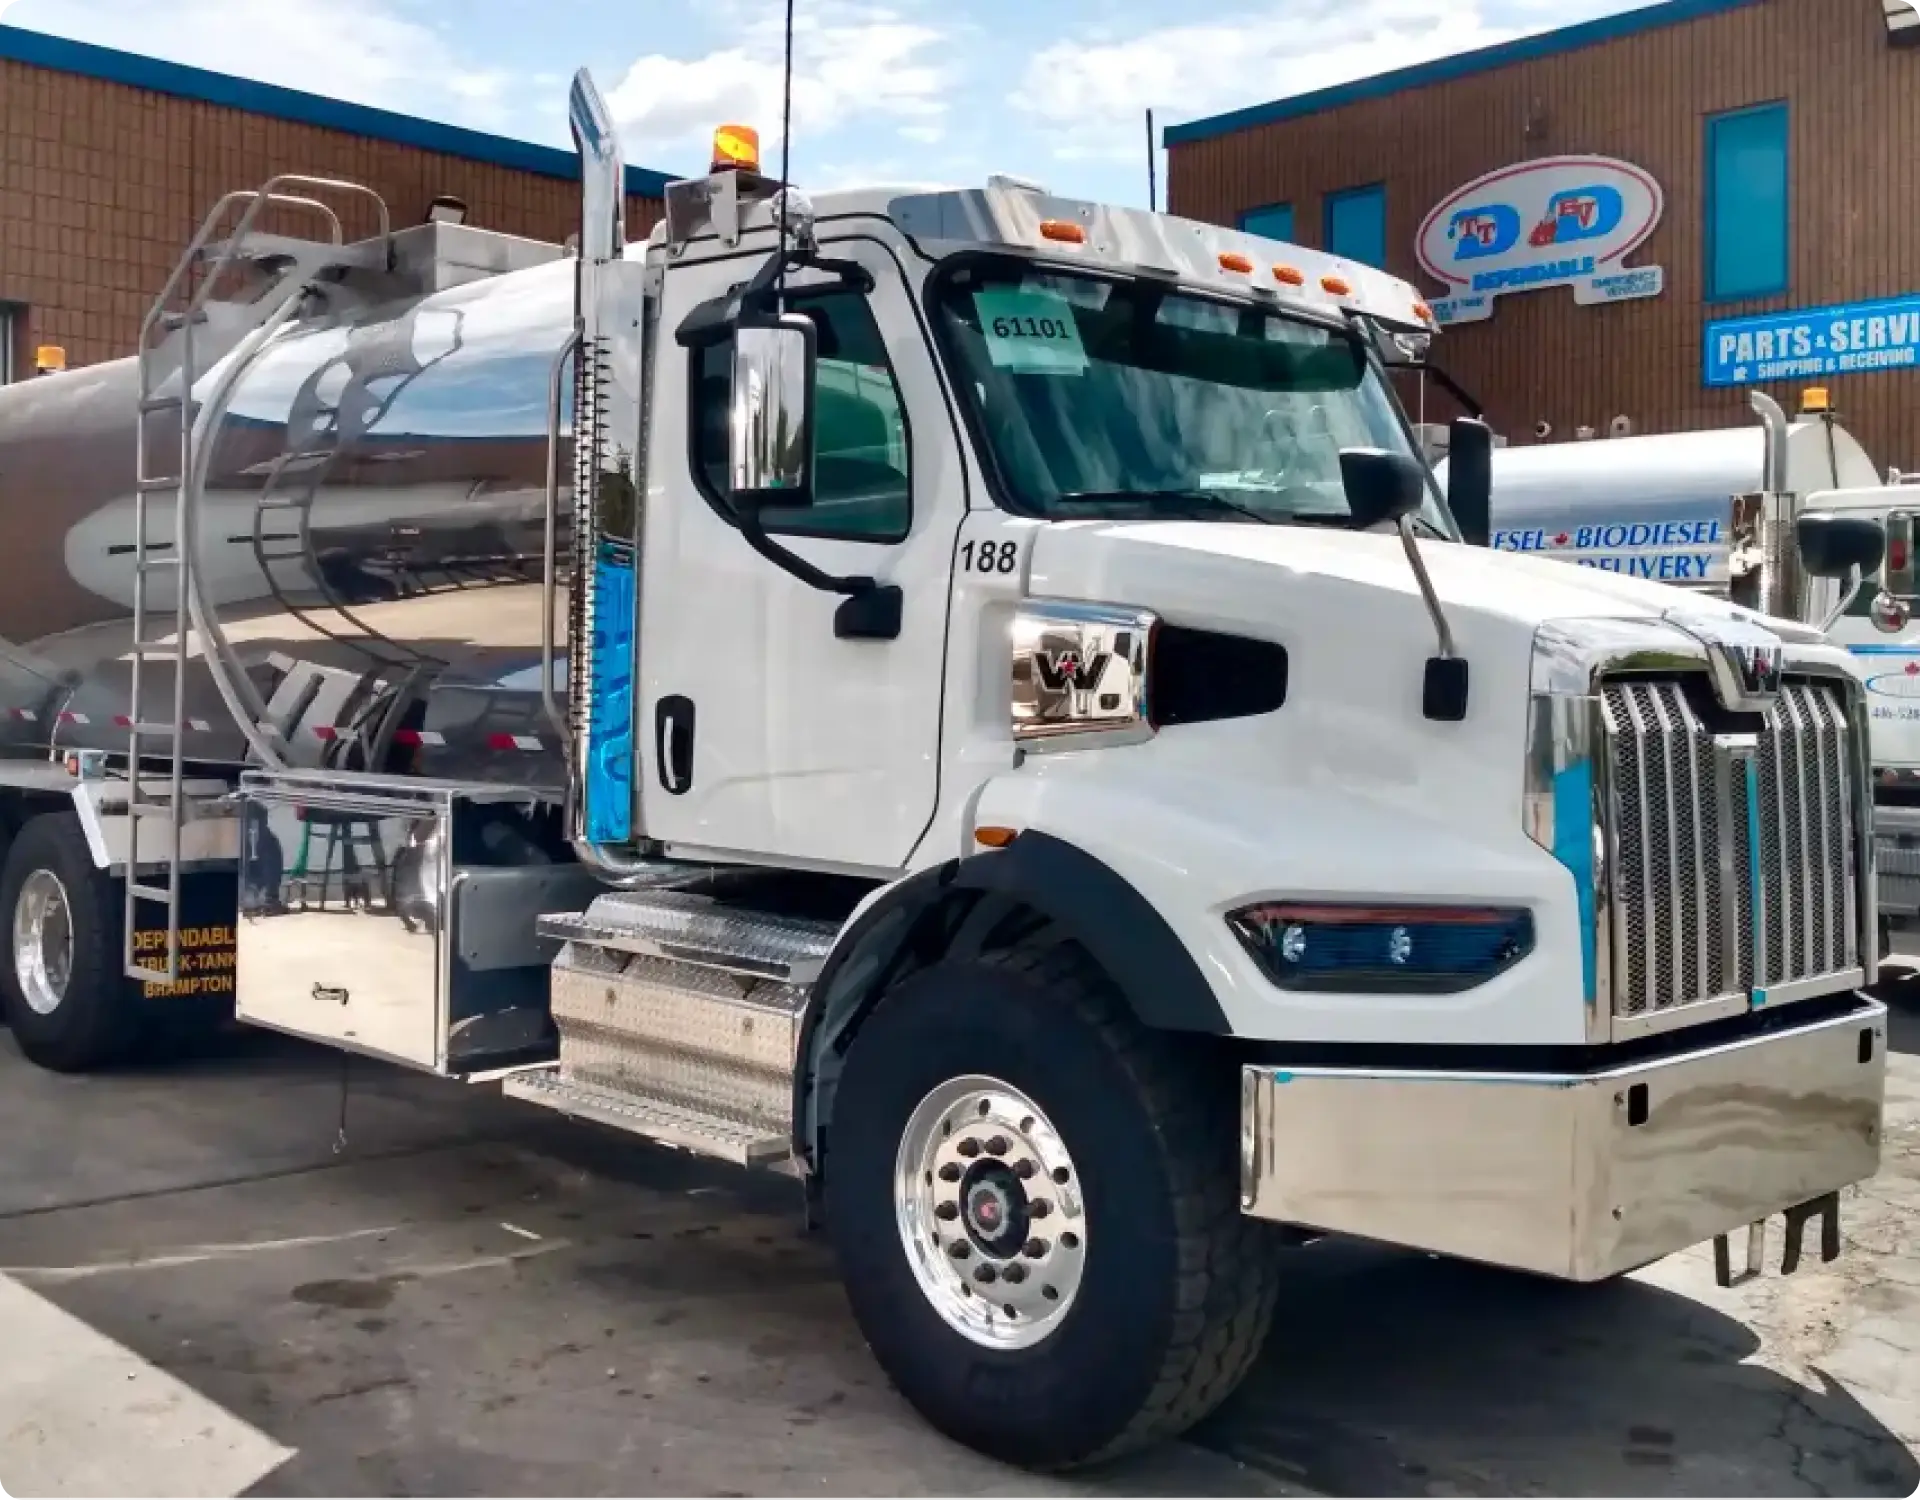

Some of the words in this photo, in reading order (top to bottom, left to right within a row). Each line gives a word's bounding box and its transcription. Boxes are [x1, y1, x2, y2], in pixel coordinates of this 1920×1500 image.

[1472, 255, 1595, 291] DEPENDABLE
[992, 316, 1072, 339] 61101
[1719, 325, 1811, 365] PARTS
[1815, 334, 1827, 348] &
[1758, 357, 1822, 378] SHIPPING
[1839, 347, 1915, 370] RECEIVING
[1575, 520, 1720, 548] BIODIESEL
[961, 540, 1019, 573] 188
[133, 926, 236, 948] DEPNDABL
[144, 975, 233, 998] BRAMPTON
